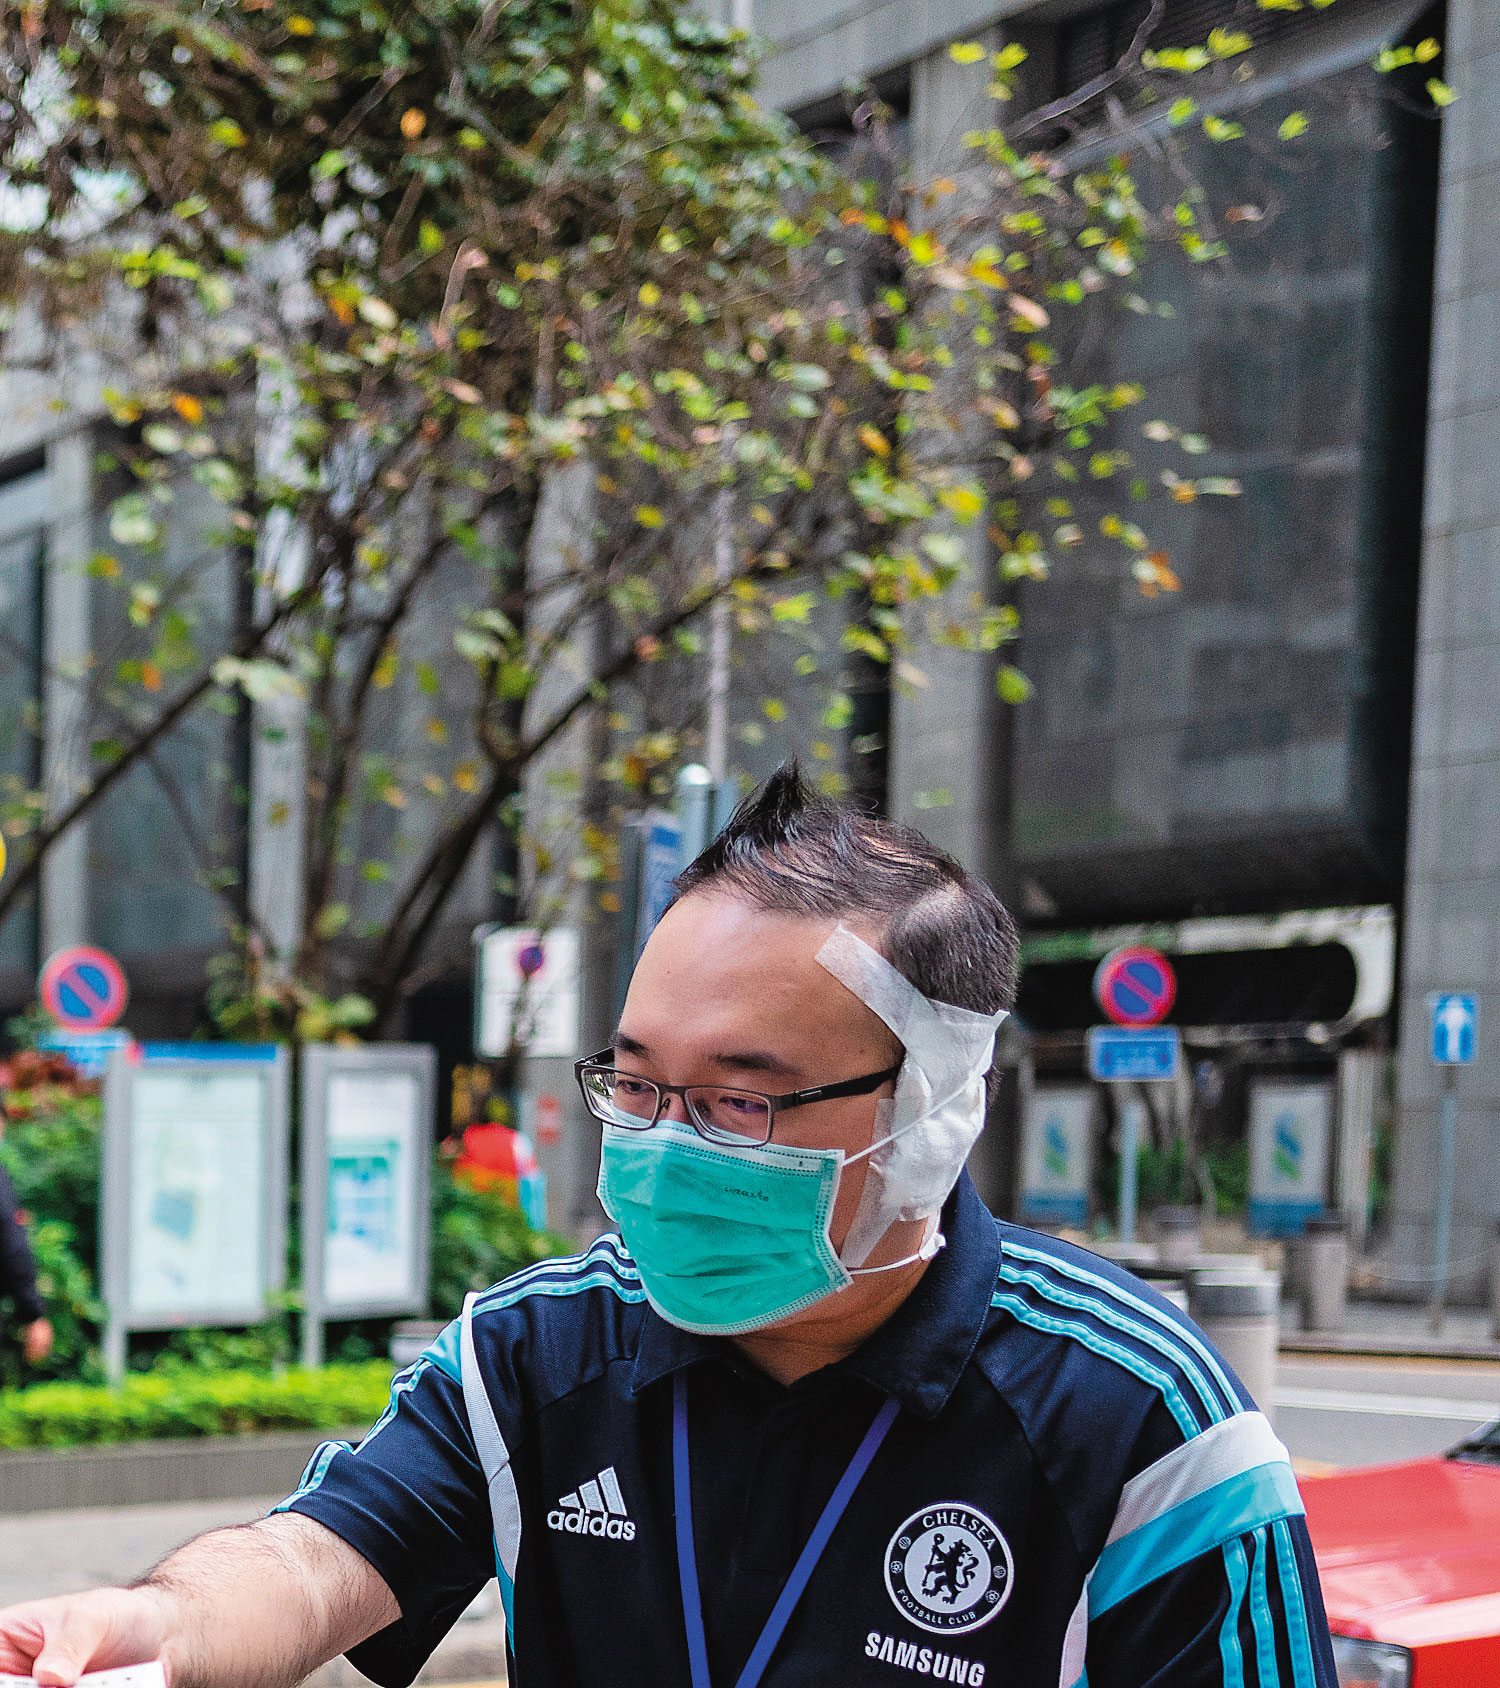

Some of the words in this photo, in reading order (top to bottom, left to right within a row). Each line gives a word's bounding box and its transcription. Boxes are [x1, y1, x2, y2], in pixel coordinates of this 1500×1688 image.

[547, 1508, 636, 1541] adidas
[922, 1511, 997, 1551] CHELSEA
[897, 1588, 943, 1625] FOOTBALL
[948, 1611, 977, 1626] CLUB
[864, 1632, 986, 1688] SAMSUNG
